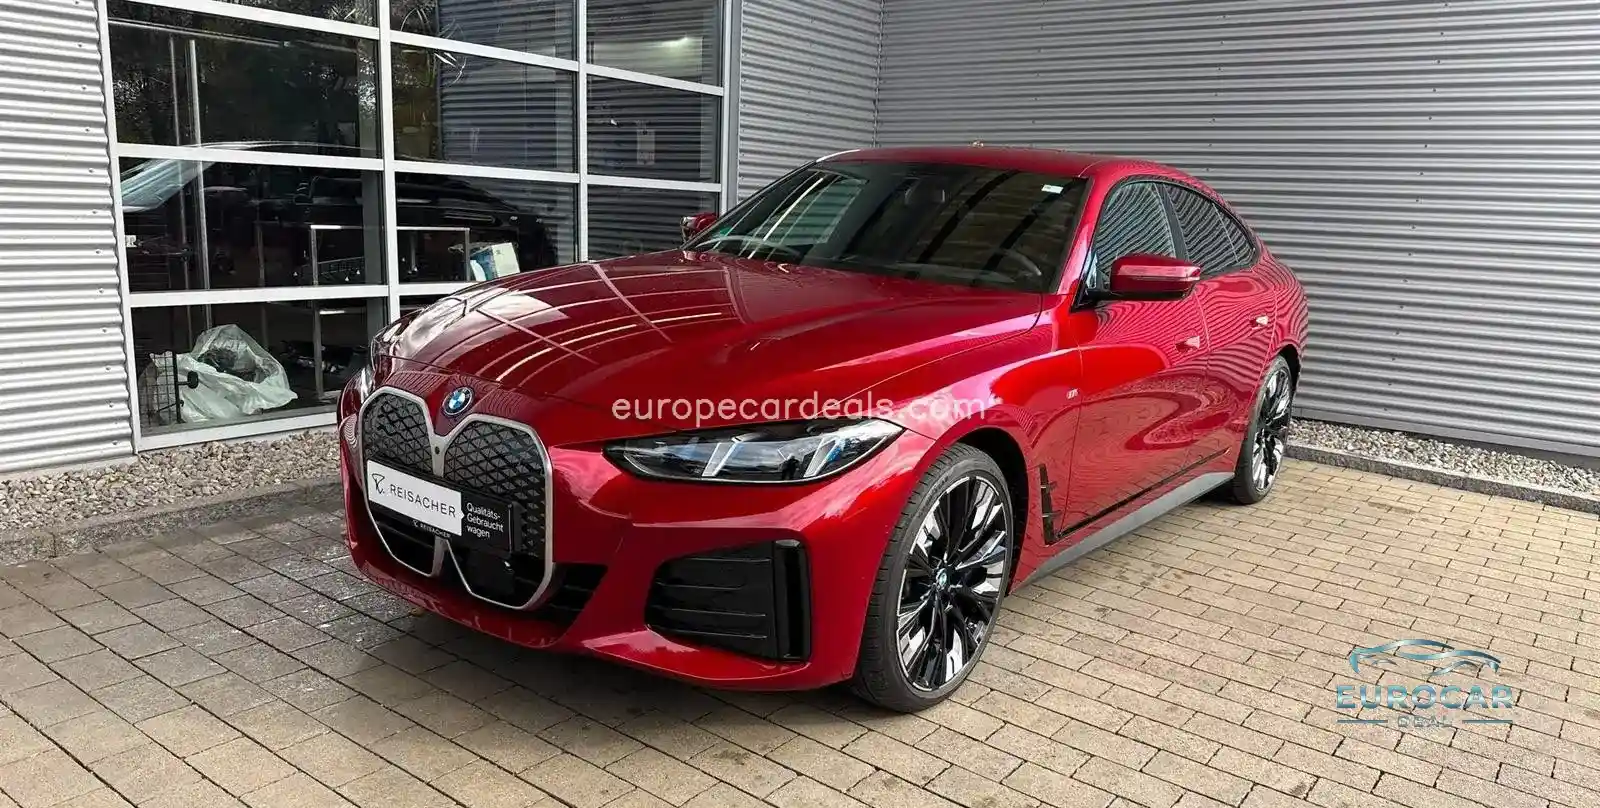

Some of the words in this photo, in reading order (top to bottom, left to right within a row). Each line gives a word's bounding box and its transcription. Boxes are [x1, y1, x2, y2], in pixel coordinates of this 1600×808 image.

[390, 483, 456, 518] REISACHER
[466, 502, 500, 520] Qualitäts-
[466, 512, 504, 533] Gebraucht
[466, 525, 490, 538] wagen
